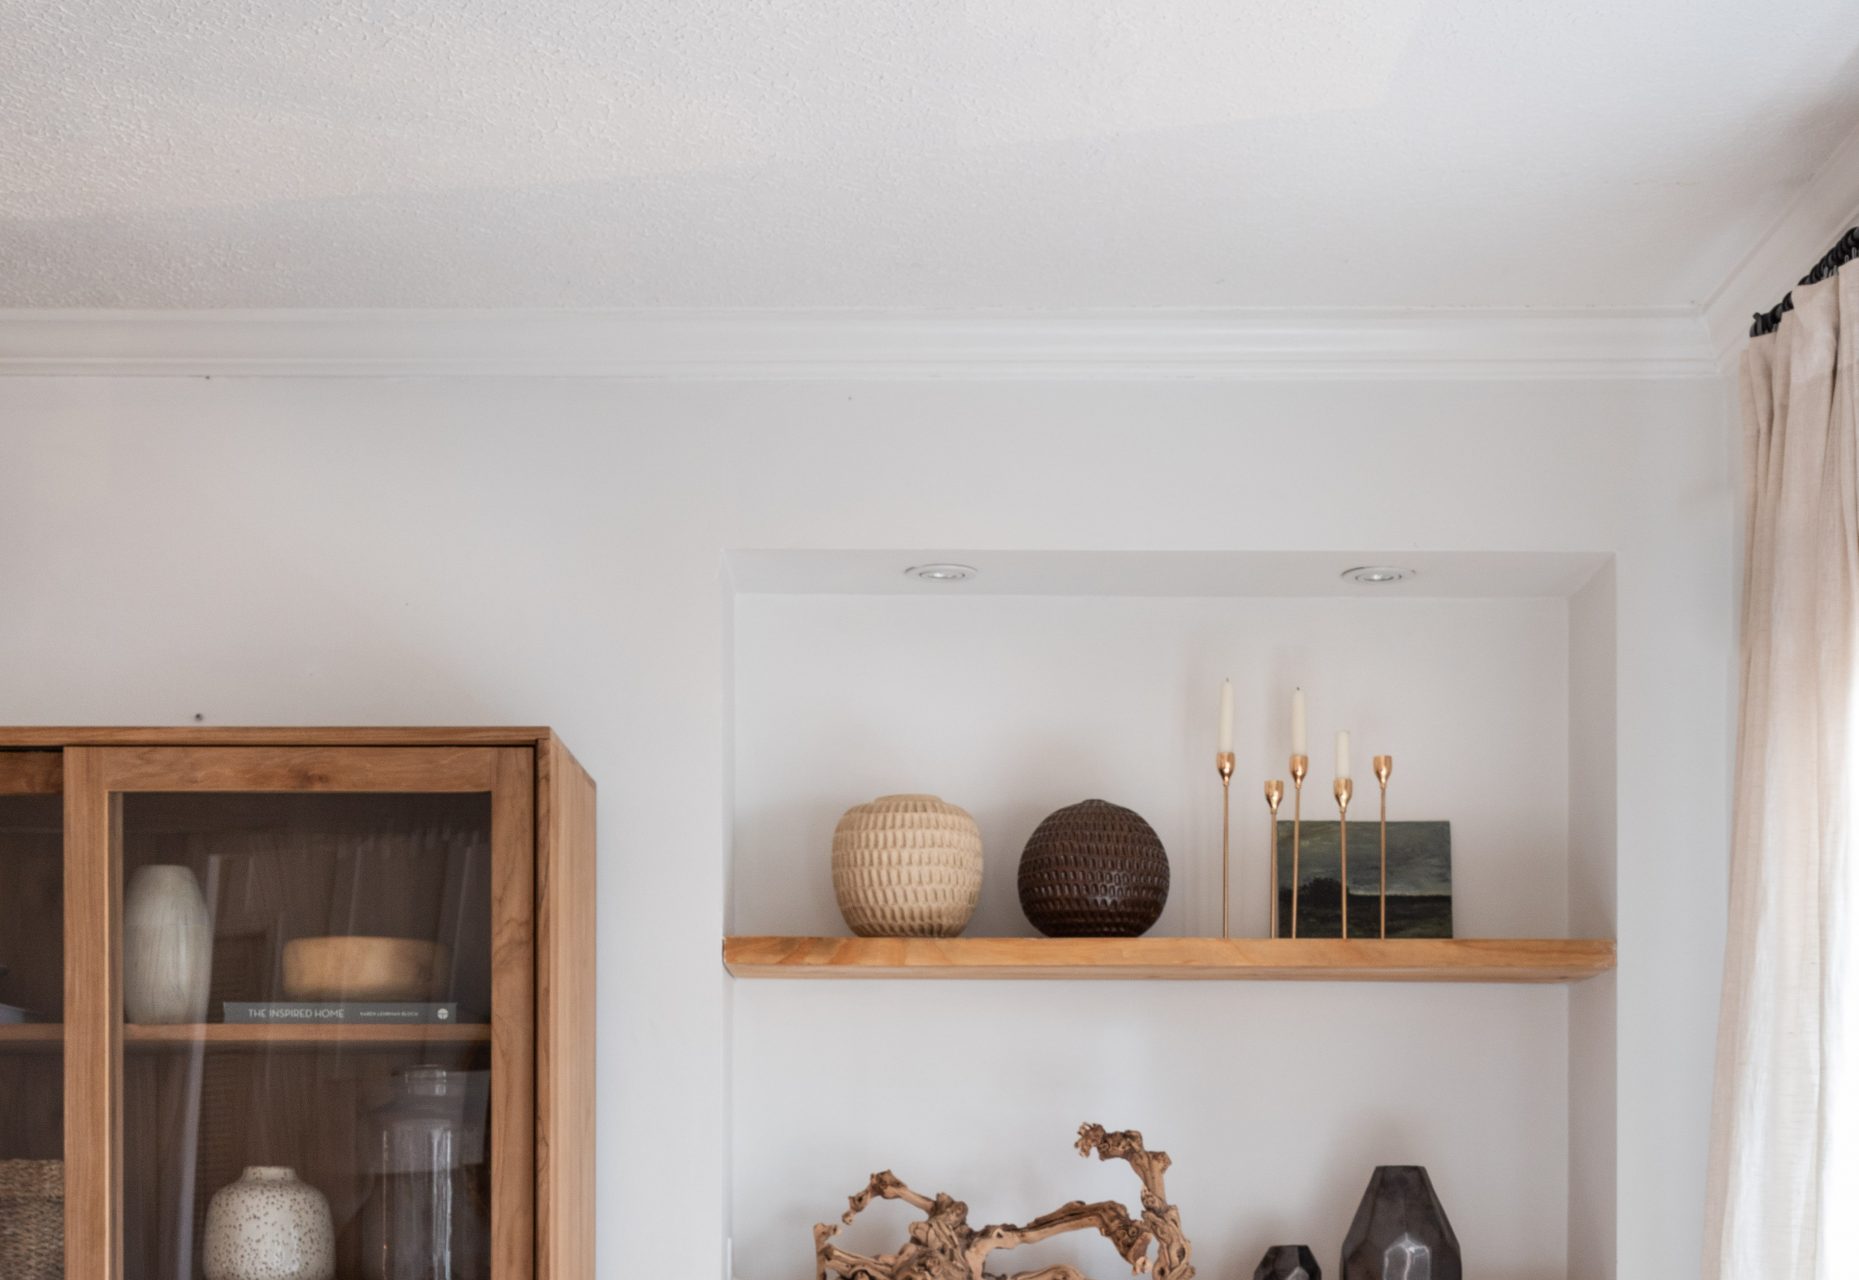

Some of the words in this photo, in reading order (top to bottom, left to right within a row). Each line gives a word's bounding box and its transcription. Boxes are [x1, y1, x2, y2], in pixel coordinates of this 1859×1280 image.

[248, 1008, 267, 1018] THE
[269, 1008, 313, 1018] INSPIRED
[314, 1008, 345, 1018] HOME
